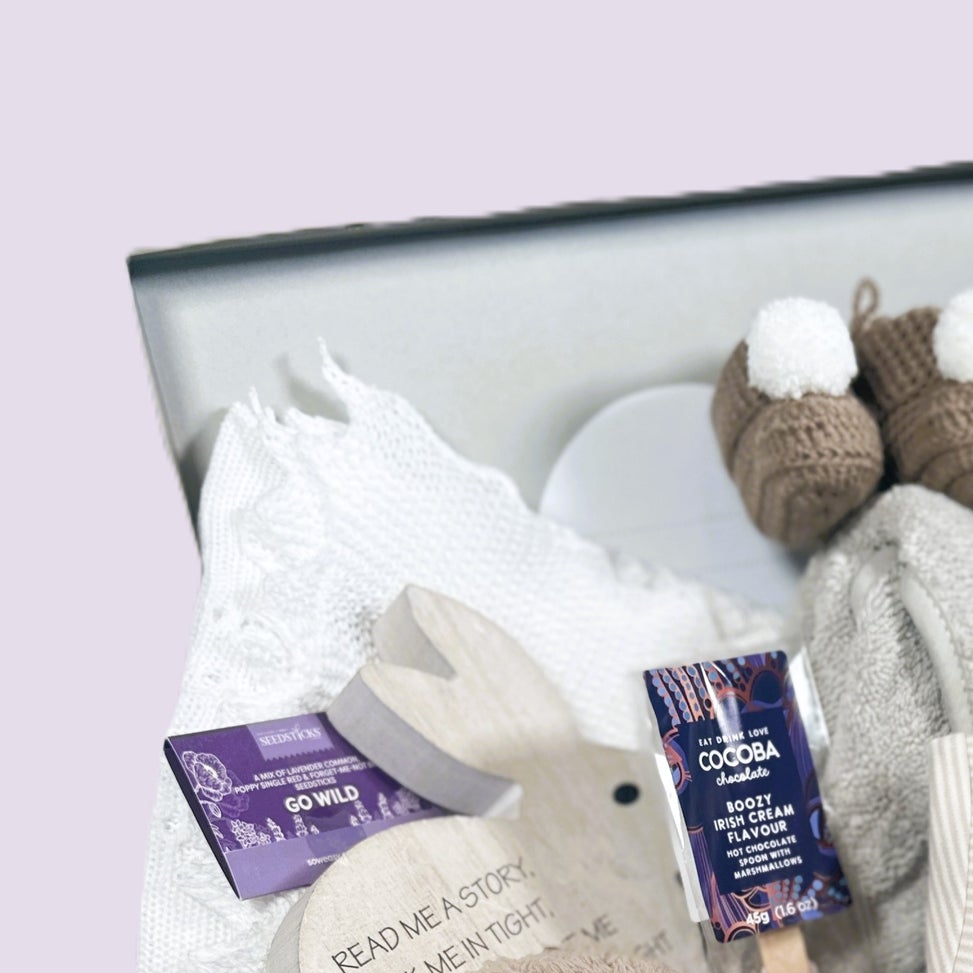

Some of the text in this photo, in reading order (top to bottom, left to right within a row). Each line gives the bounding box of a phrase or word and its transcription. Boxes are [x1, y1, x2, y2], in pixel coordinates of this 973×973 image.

[698, 726, 769, 747] EAT DRINK LOVE
[698, 740, 781, 772] COCOBA
[253, 774, 260, 782] A
[260, 772, 275, 780] MIX
[277, 769, 286, 778] OF
[287, 761, 323, 776] LAVENDER
[716, 766, 770, 786] chocolate
[234, 784, 259, 794] POPPY
[260, 779, 287, 790] SINGLE
[287, 774, 302, 784] RED
[302, 774, 309, 782] &
[294, 777, 337, 791] SEEDSTICKS
[285, 785, 360, 813] GO WILD
[726, 793, 772, 813] BOOZY
[713, 803, 795, 832] IRISH CREAM
[727, 820, 788, 844] FLAVOUR
[726, 834, 797, 858] HOT CHOCOLATE
[738, 847, 791, 867] SPOON WITH
[733, 856, 803, 879] MARSHMALLOWS
[399, 905, 442, 942] ME
[441, 897, 463, 921] A
[746, 911, 770, 925] 45g
[460, 931, 491, 961] IN
